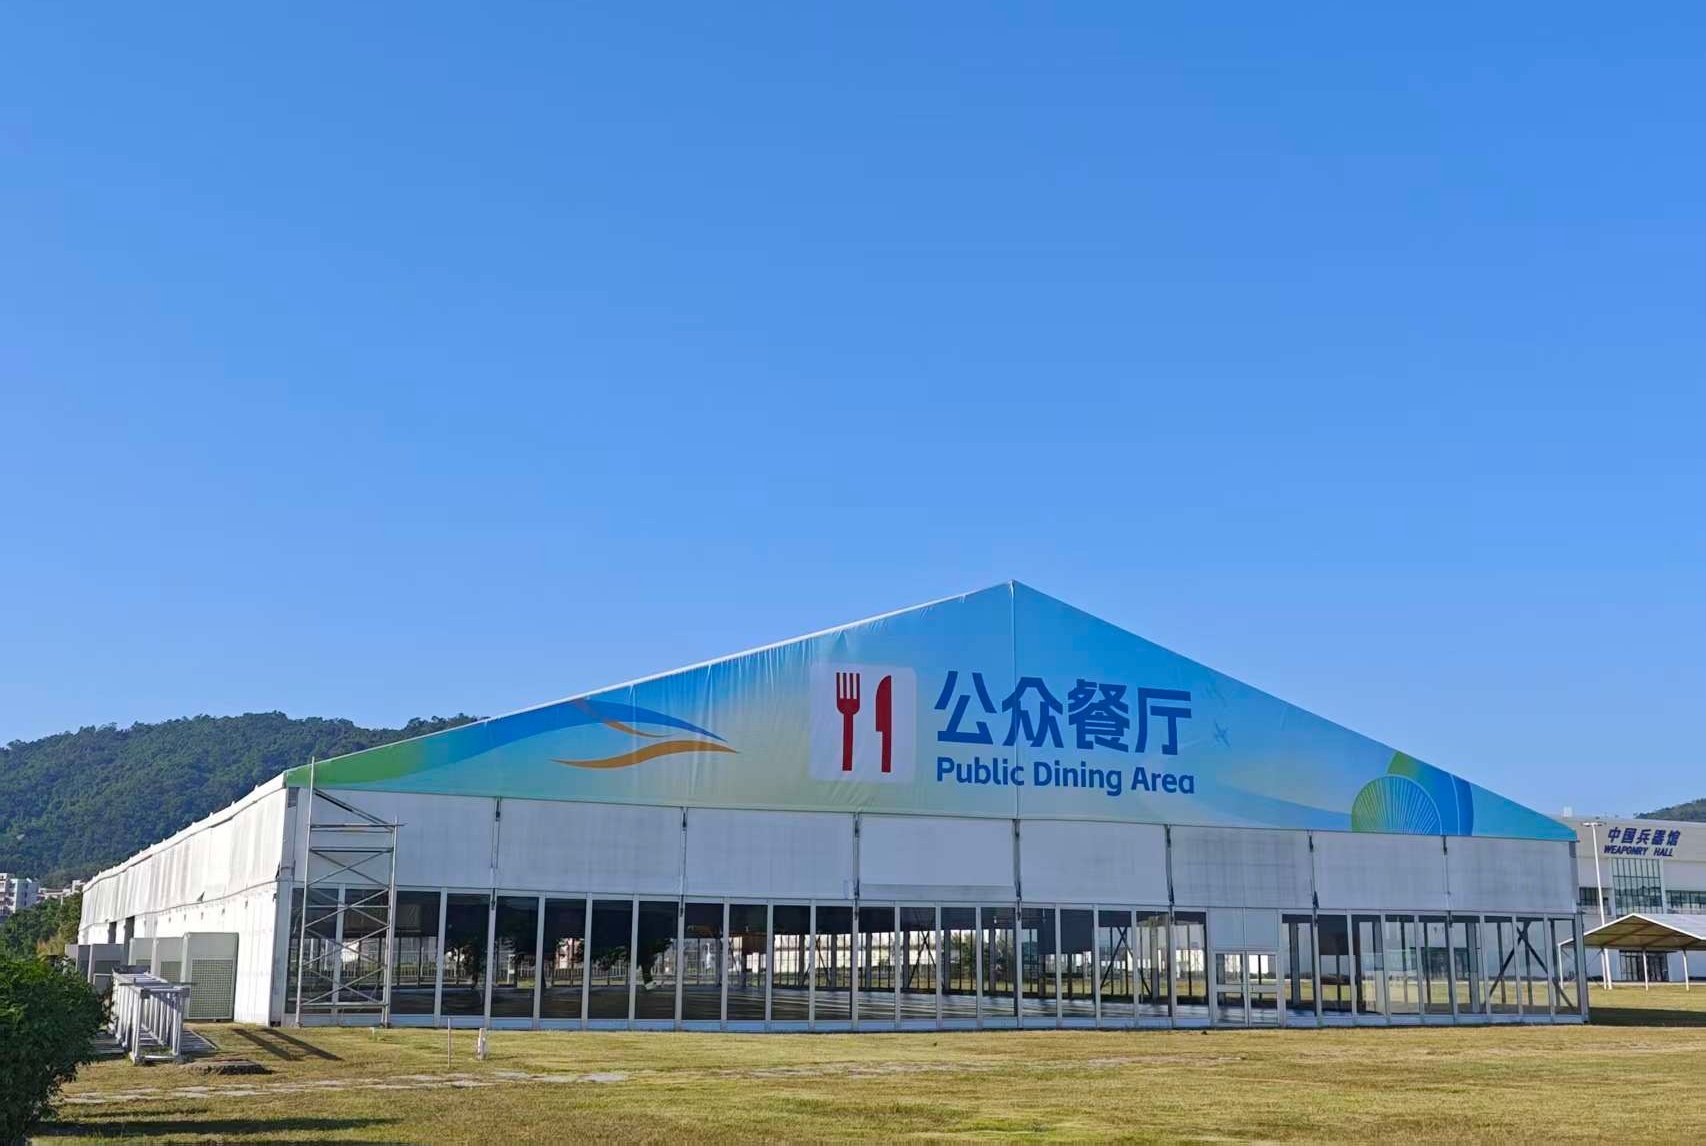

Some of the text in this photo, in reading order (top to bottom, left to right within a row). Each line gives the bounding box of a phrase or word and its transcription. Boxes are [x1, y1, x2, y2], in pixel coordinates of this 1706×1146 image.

[934, 670, 1192, 755] 公众餐厅
[936, 756, 1195, 797] Public Dining Area
[1603, 845, 1674, 857] WEAPONRY HALL
[1608, 827, 1681, 846] 中国兵器馆
